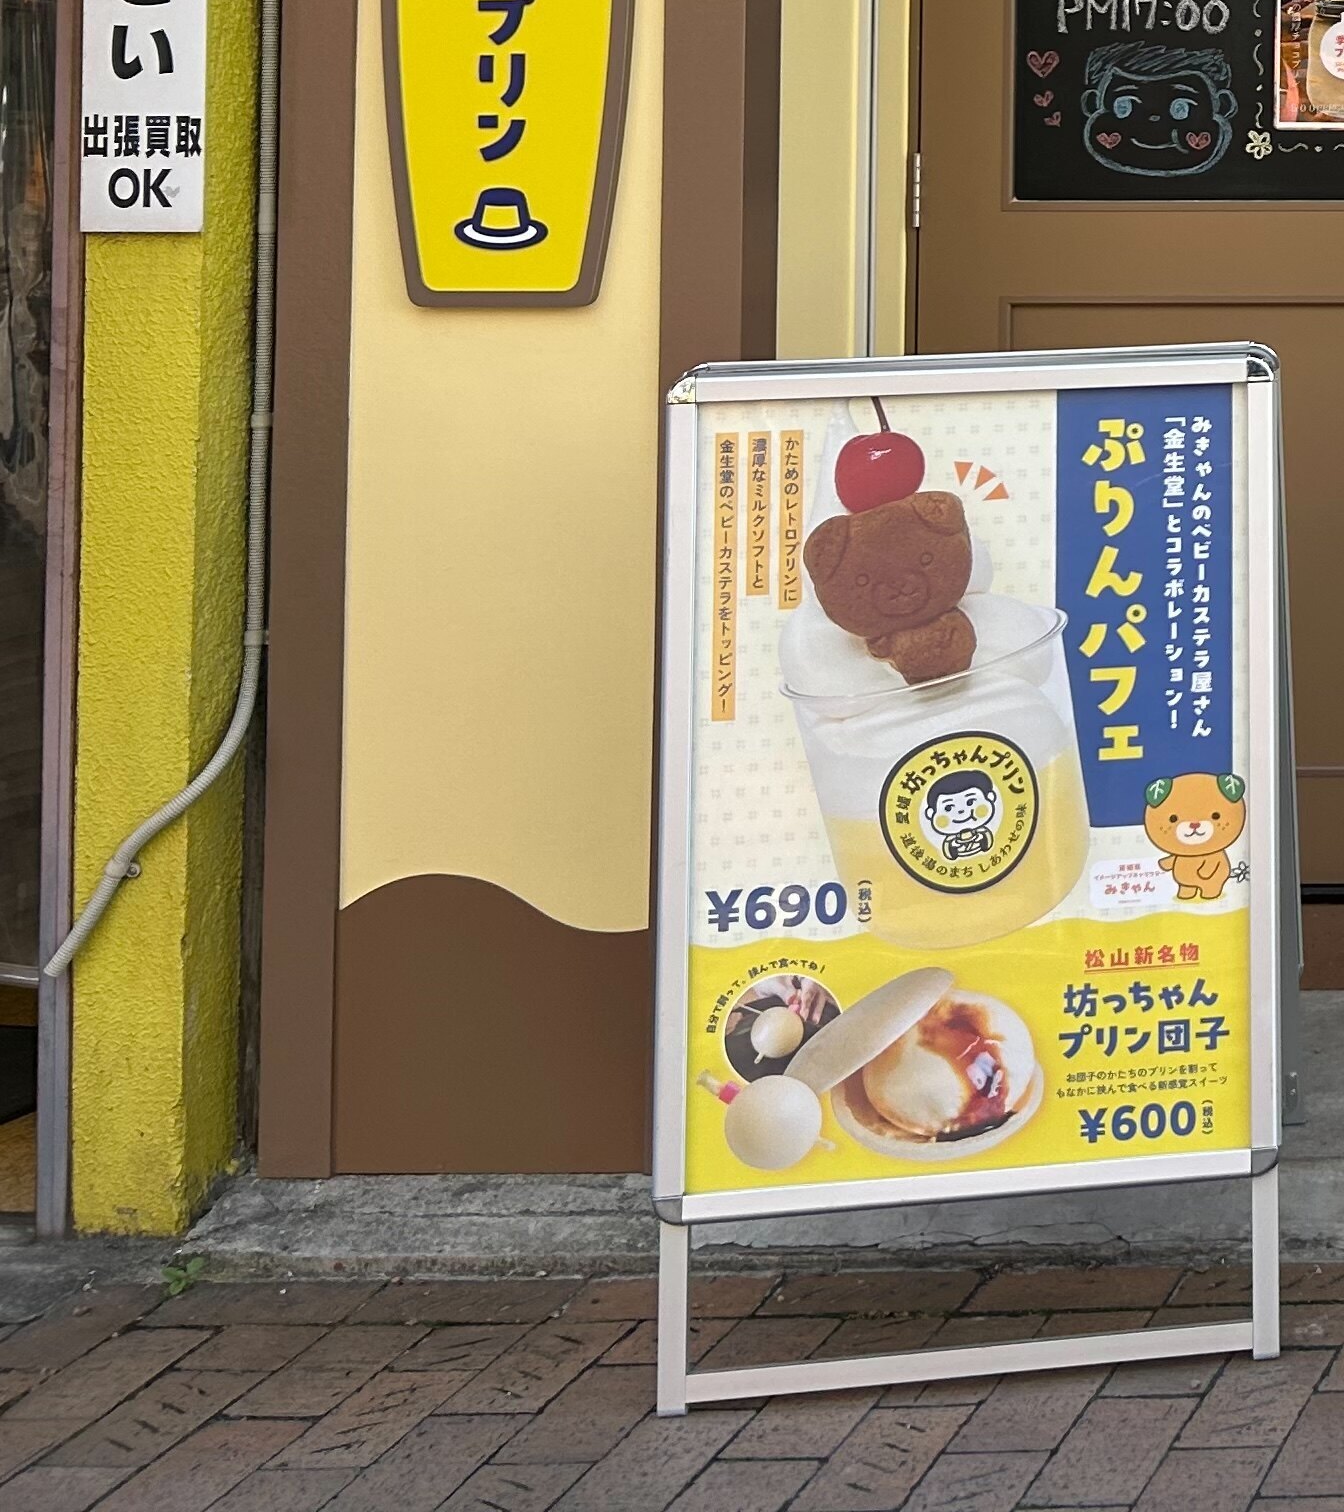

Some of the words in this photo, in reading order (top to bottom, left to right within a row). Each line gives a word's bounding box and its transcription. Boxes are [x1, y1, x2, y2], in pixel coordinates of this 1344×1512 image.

[82, 114, 202, 157] 出張買取
[107, 166, 172, 210] OK
[751, 438, 767, 589] 濃厚なミルクソフトと
[784, 437, 799, 602] かためのレトロプリンに
[717, 440, 735, 713] 金生堂のベビーカステラをトッピング!
[1079, 418, 1147, 761] ぷりんパフェ
[1161, 416, 1186, 730] 「金生堂」とコラボレーション!
[1191, 416, 1213, 738] みきゃんのベビーカステラ屋さん
[900, 745, 1025, 795] 坊っちゃんプリン
[895, 795, 912, 825] 愛媛
[900, 833, 973, 878] 道後湯のまち
[978, 802, 1027, 873] しあわせの味
[705, 882, 847, 932] ¥690
[857, 879, 872, 922] (税込)
[1105, 881, 1155, 894] みきゃん
[1084, 942, 1200, 968] 松山新名物
[1064, 978, 1218, 1018] 坊っちゃん
[1059, 1016, 1230, 1059] プリン団子
[1056, 1075, 1228, 1098] もなかに挟んで食べる新感覚スイーツ
[1067, 1063, 1218, 1083] お団子のかたちのプリンを割って
[1078, 1100, 1196, 1143] ¥600
